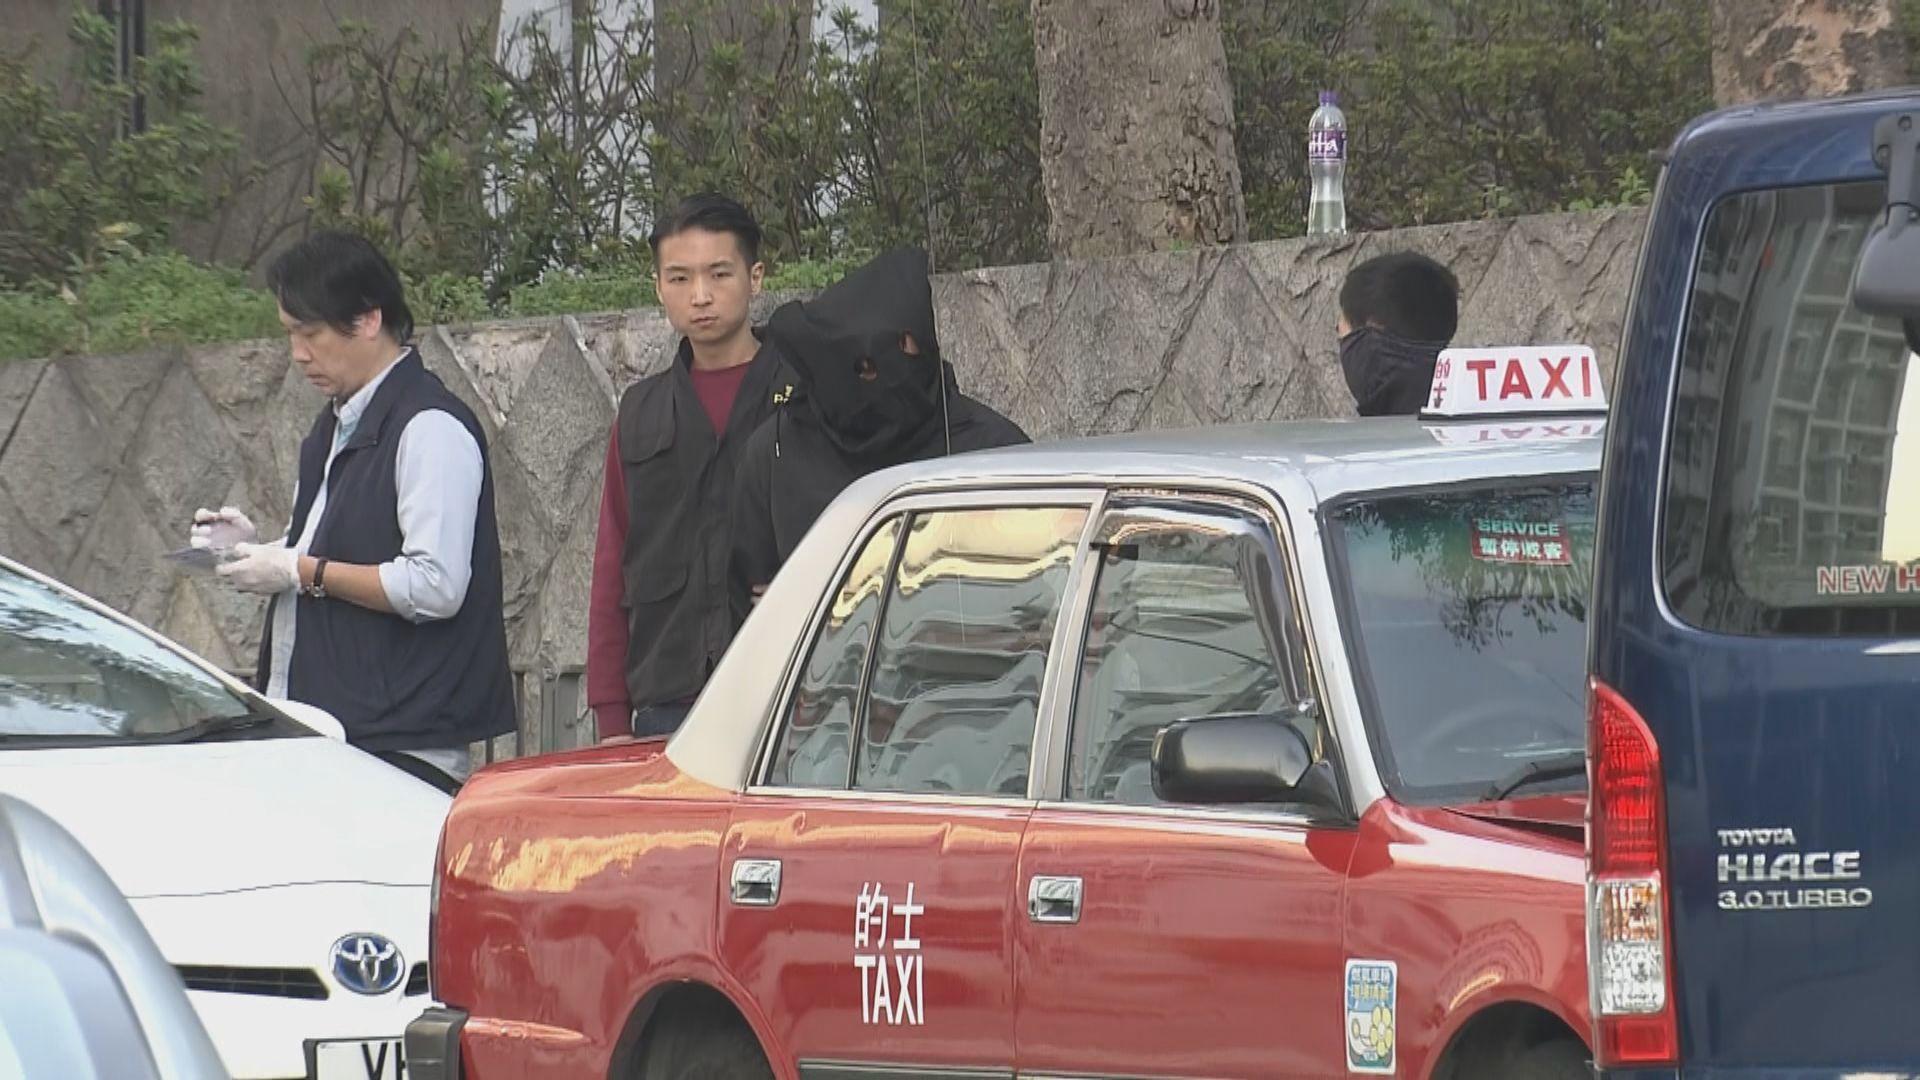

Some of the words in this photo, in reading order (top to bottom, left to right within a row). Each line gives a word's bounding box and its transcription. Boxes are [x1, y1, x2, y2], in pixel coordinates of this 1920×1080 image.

[1433, 358, 1450, 408] 的士
[1466, 356, 1592, 400] TAXI
[1478, 517, 1560, 536] SERVICE
[1817, 566, 1890, 593] NEW
[1717, 828, 1796, 846] TOYOTA
[1717, 850, 1861, 882] HIACE
[855, 881, 924, 950] 的士
[854, 955, 924, 1025] TAXI
